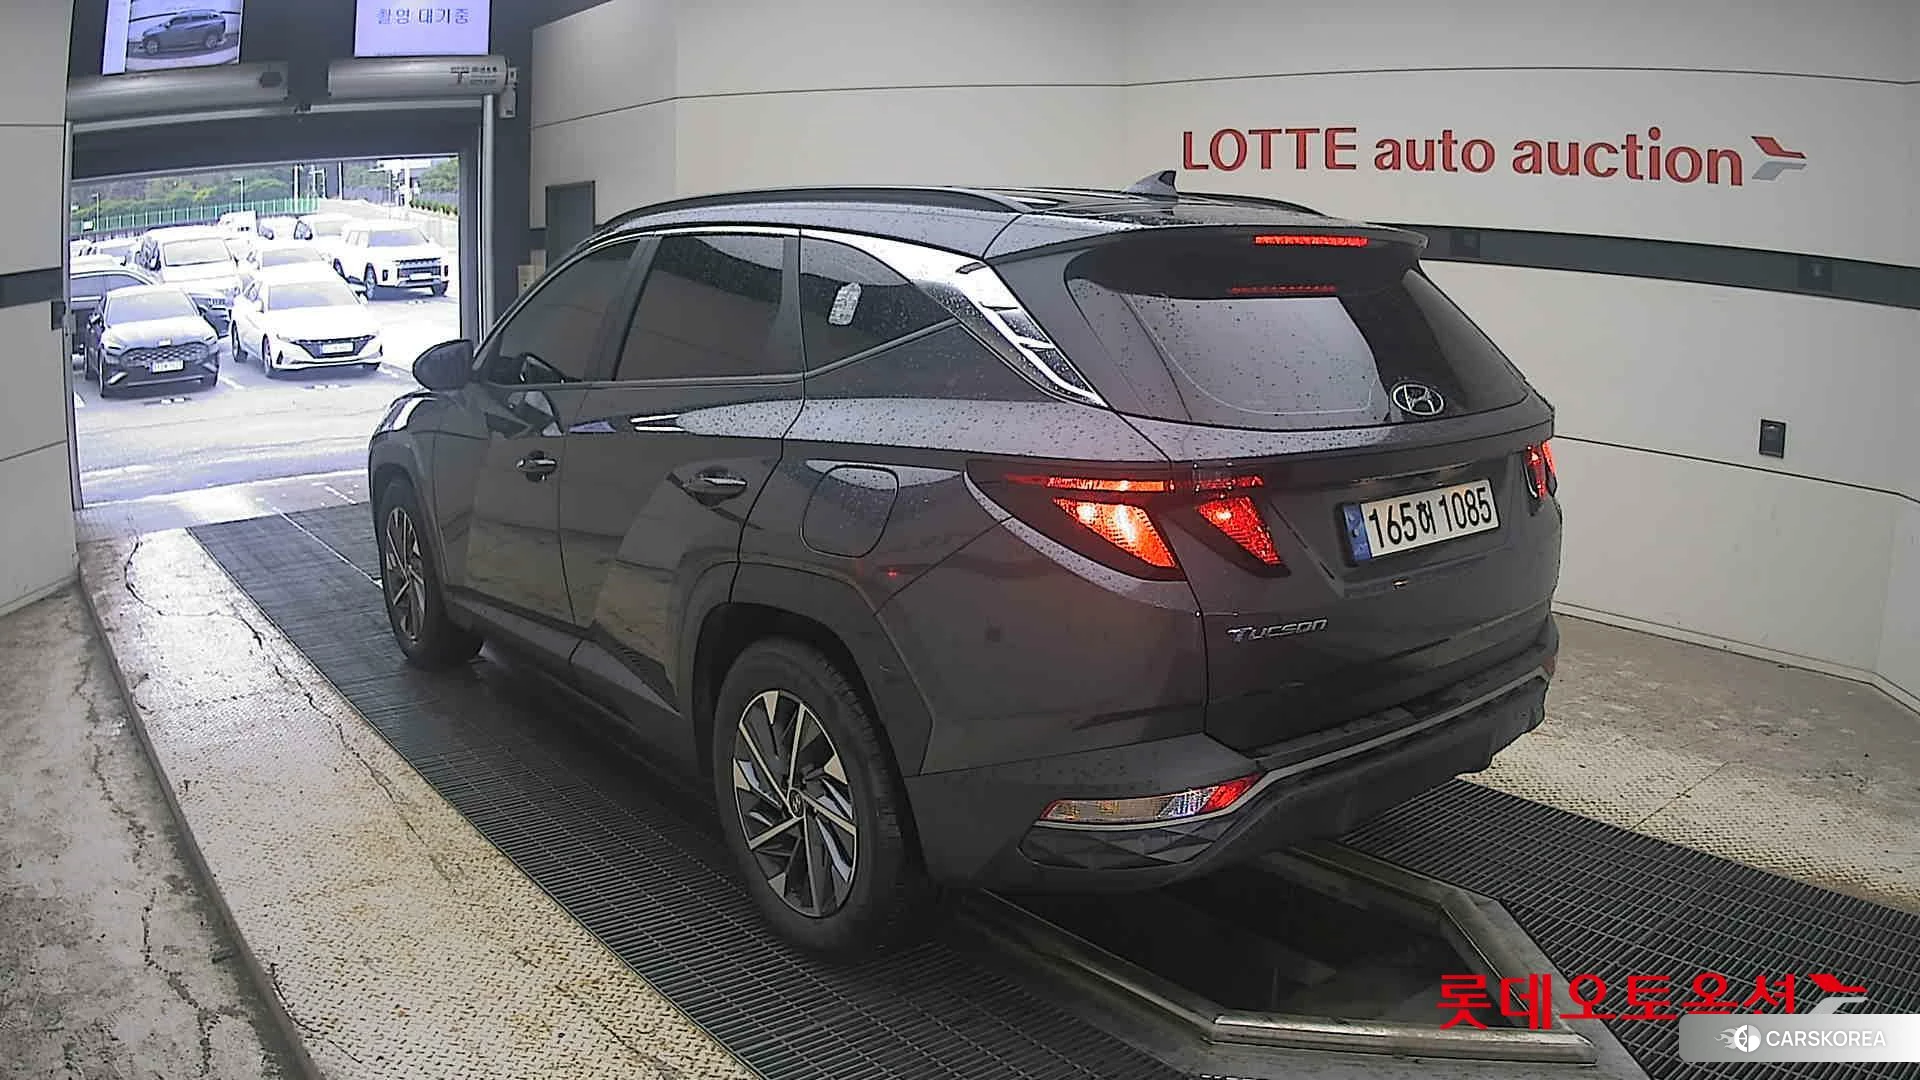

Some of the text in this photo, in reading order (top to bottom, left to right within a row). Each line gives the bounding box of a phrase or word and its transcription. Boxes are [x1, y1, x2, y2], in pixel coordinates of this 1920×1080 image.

[1182, 126, 1744, 186] LOTTE auto auction
[1368, 486, 1492, 549] 165허 1085
